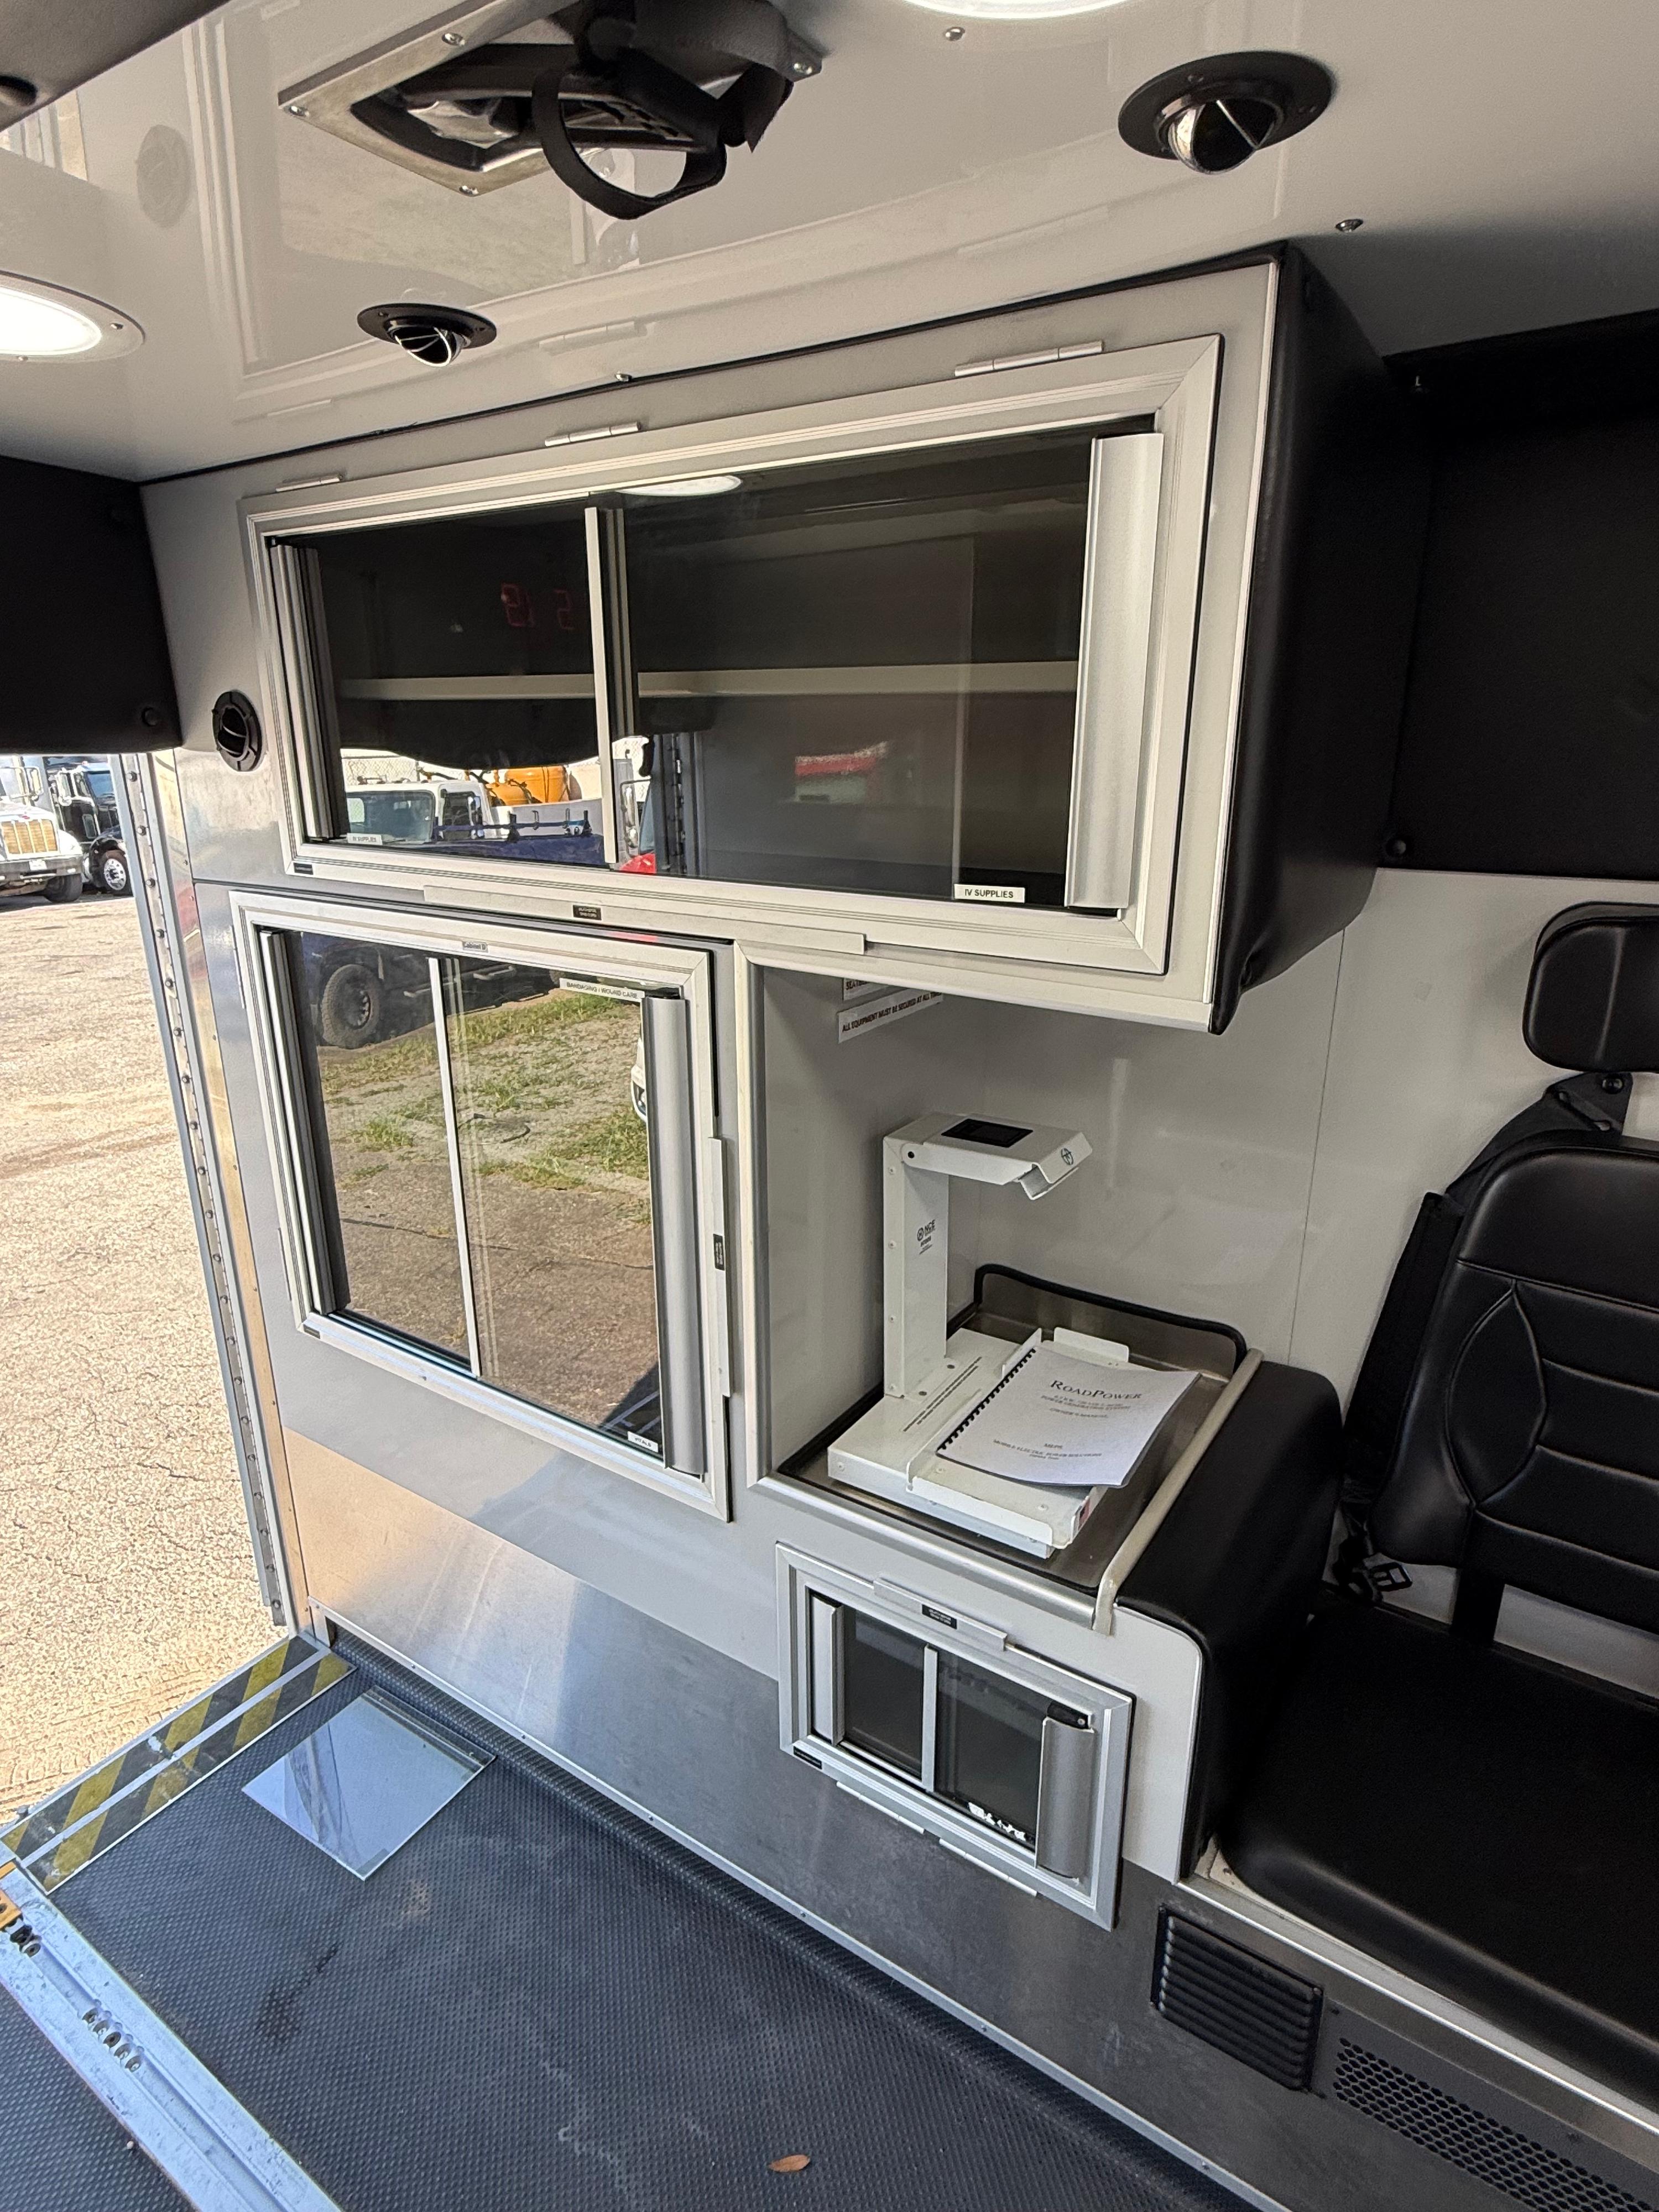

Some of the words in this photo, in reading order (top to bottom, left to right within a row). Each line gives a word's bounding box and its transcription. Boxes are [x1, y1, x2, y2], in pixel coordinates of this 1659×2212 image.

[974, 889, 1014, 899] SUPPLIES
[601, 987, 621, 997] WOUND
[622, 990, 638, 999] CARE
[842, 1022, 851, 1032] ALL
[851, 1012, 878, 1029] EQUIPMENT
[878, 1007, 891, 1018] MUST
[892, 1004, 898, 1014] BE
[898, 998, 916, 1012] SECURED
[916, 995, 922, 1004] AT
